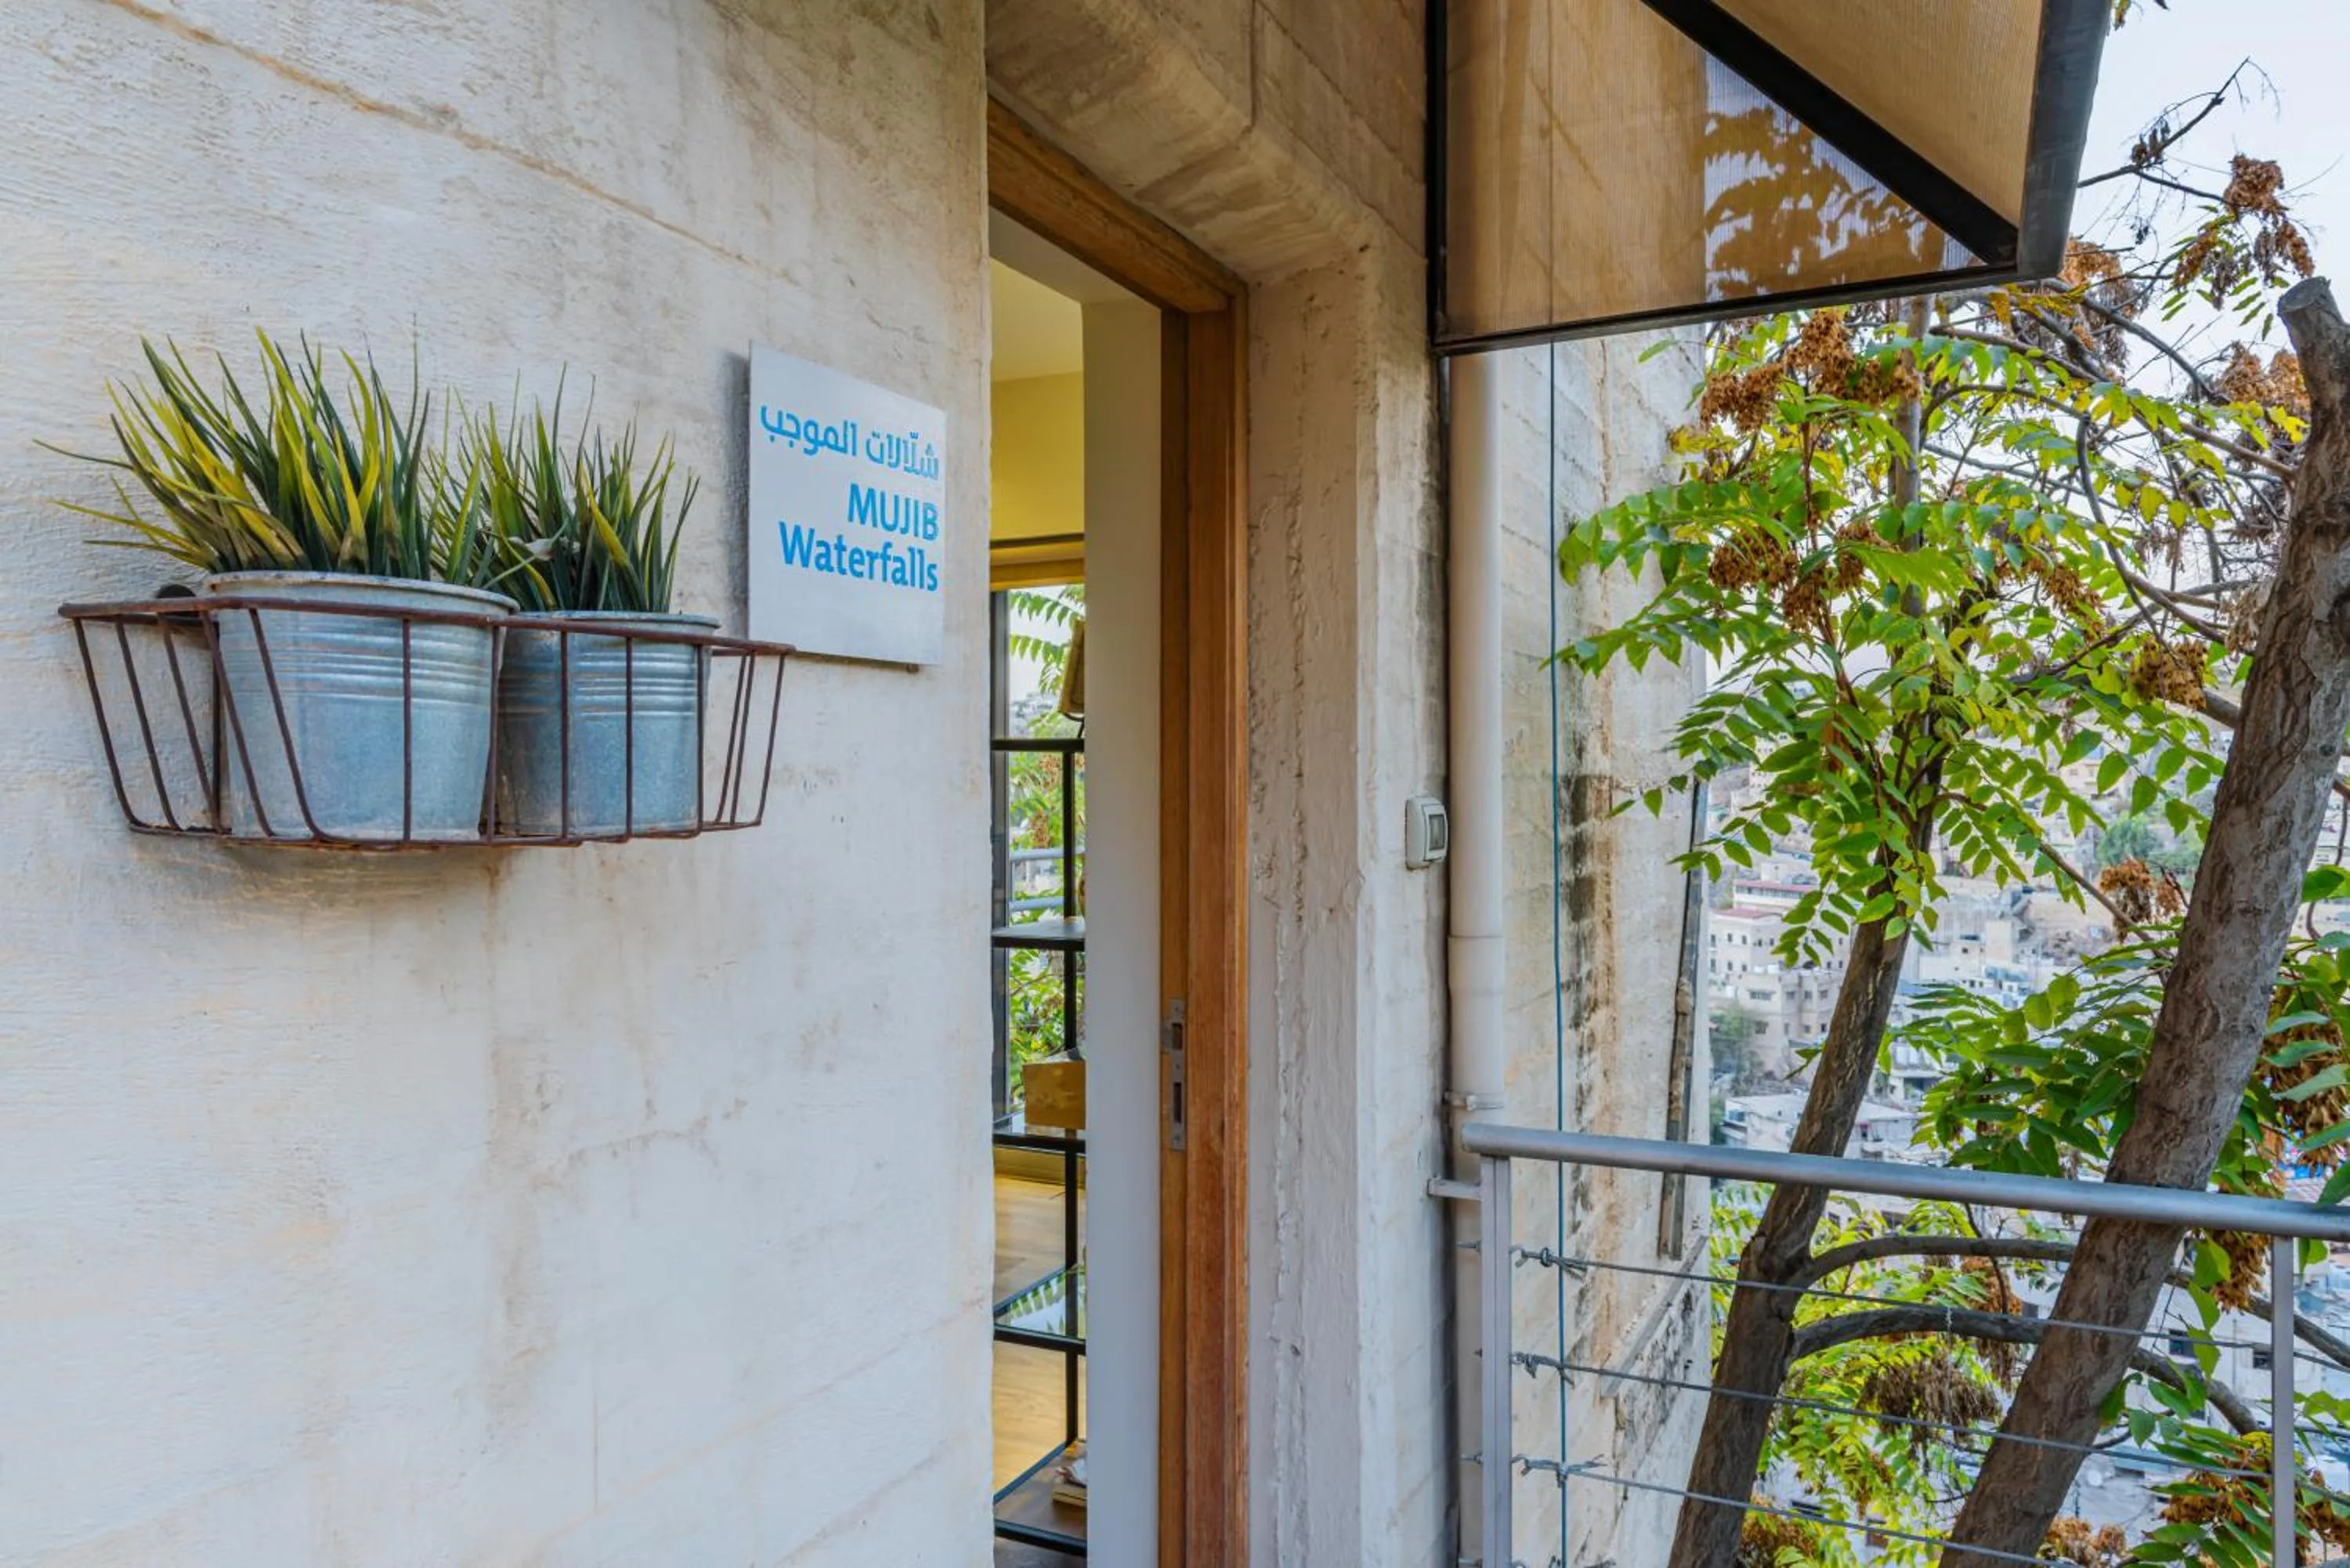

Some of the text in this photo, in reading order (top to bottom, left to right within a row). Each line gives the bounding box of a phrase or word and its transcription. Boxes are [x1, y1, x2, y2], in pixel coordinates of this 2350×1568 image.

[760, 405, 858, 457] الموجب
[847, 482, 938, 541] MUJIB
[778, 520, 938, 592] Waterfalls
